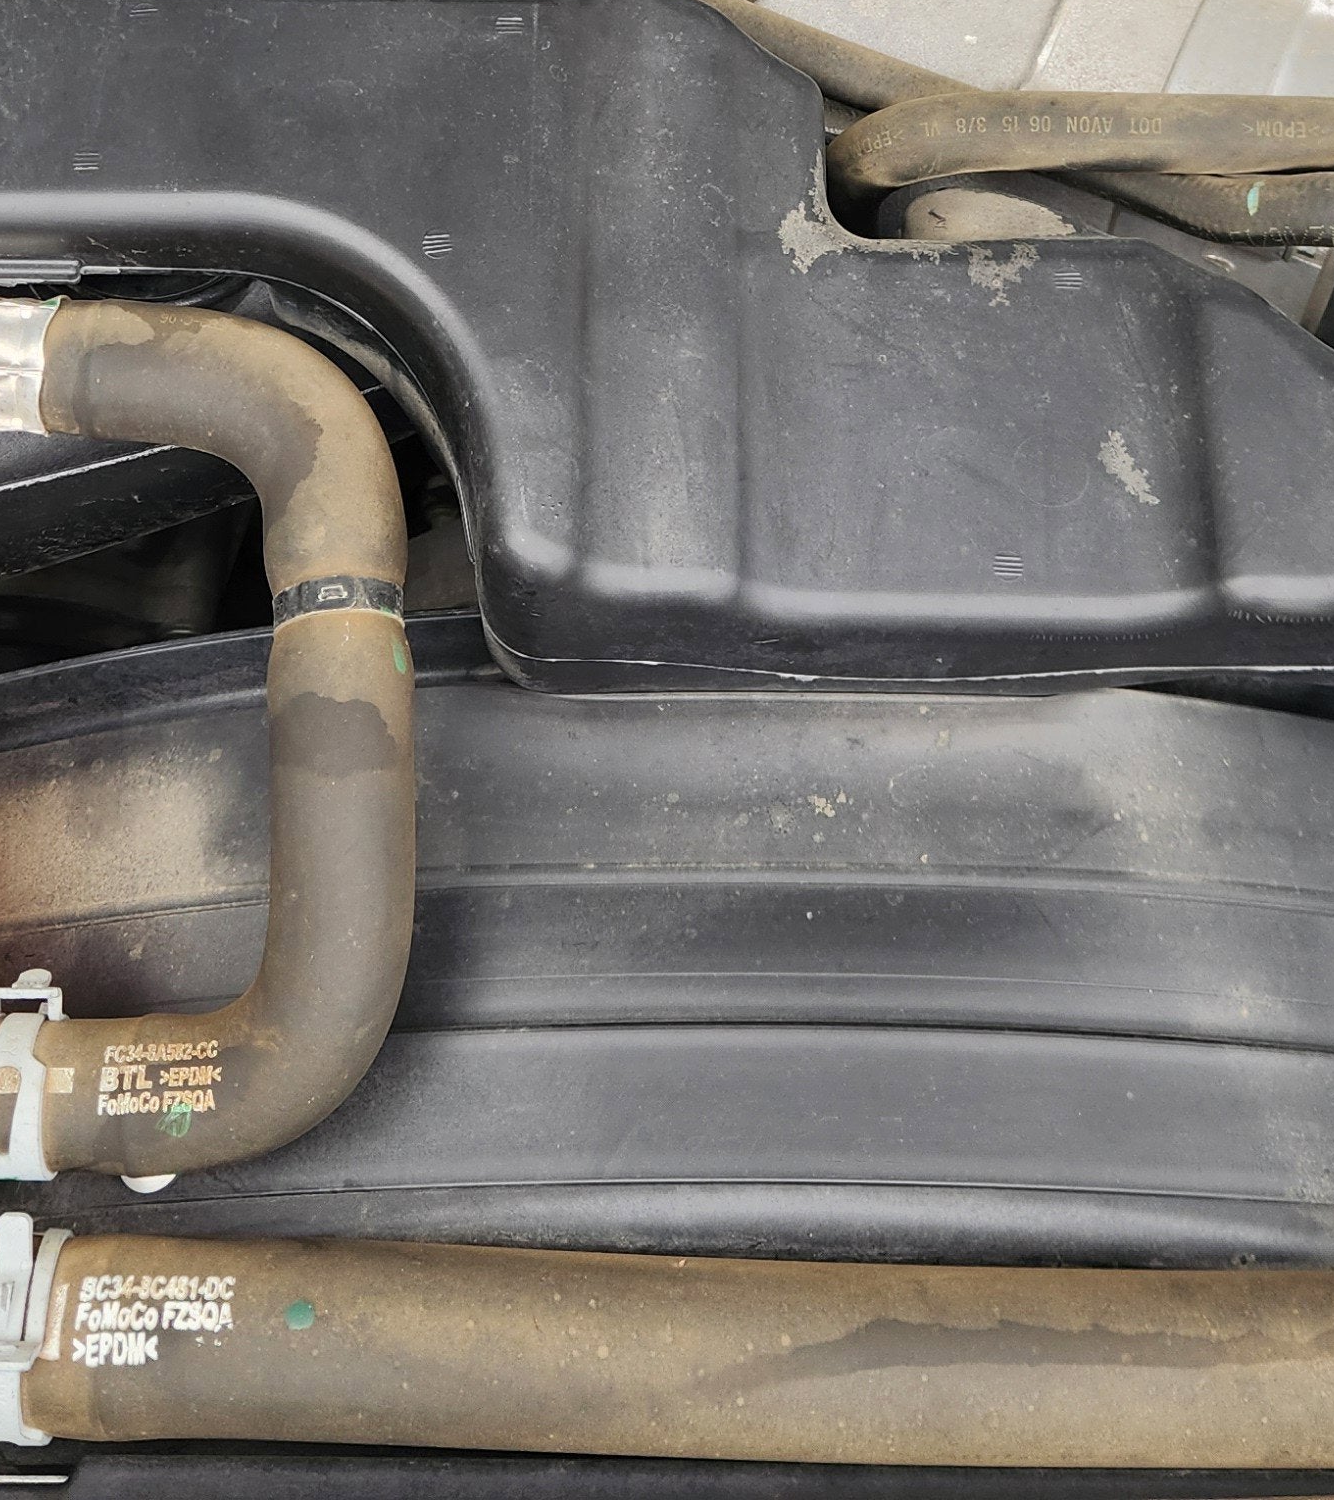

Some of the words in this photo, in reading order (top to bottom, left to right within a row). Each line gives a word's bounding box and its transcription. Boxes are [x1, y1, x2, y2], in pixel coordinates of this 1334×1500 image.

[1066, 116, 1114, 135] AVON
[1129, 117, 1162, 135] DOT
[99, 1065, 153, 1092] BTL
[97, 1091, 160, 1116] FoMoCo
[74, 1300, 159, 1331] FoMoCo
